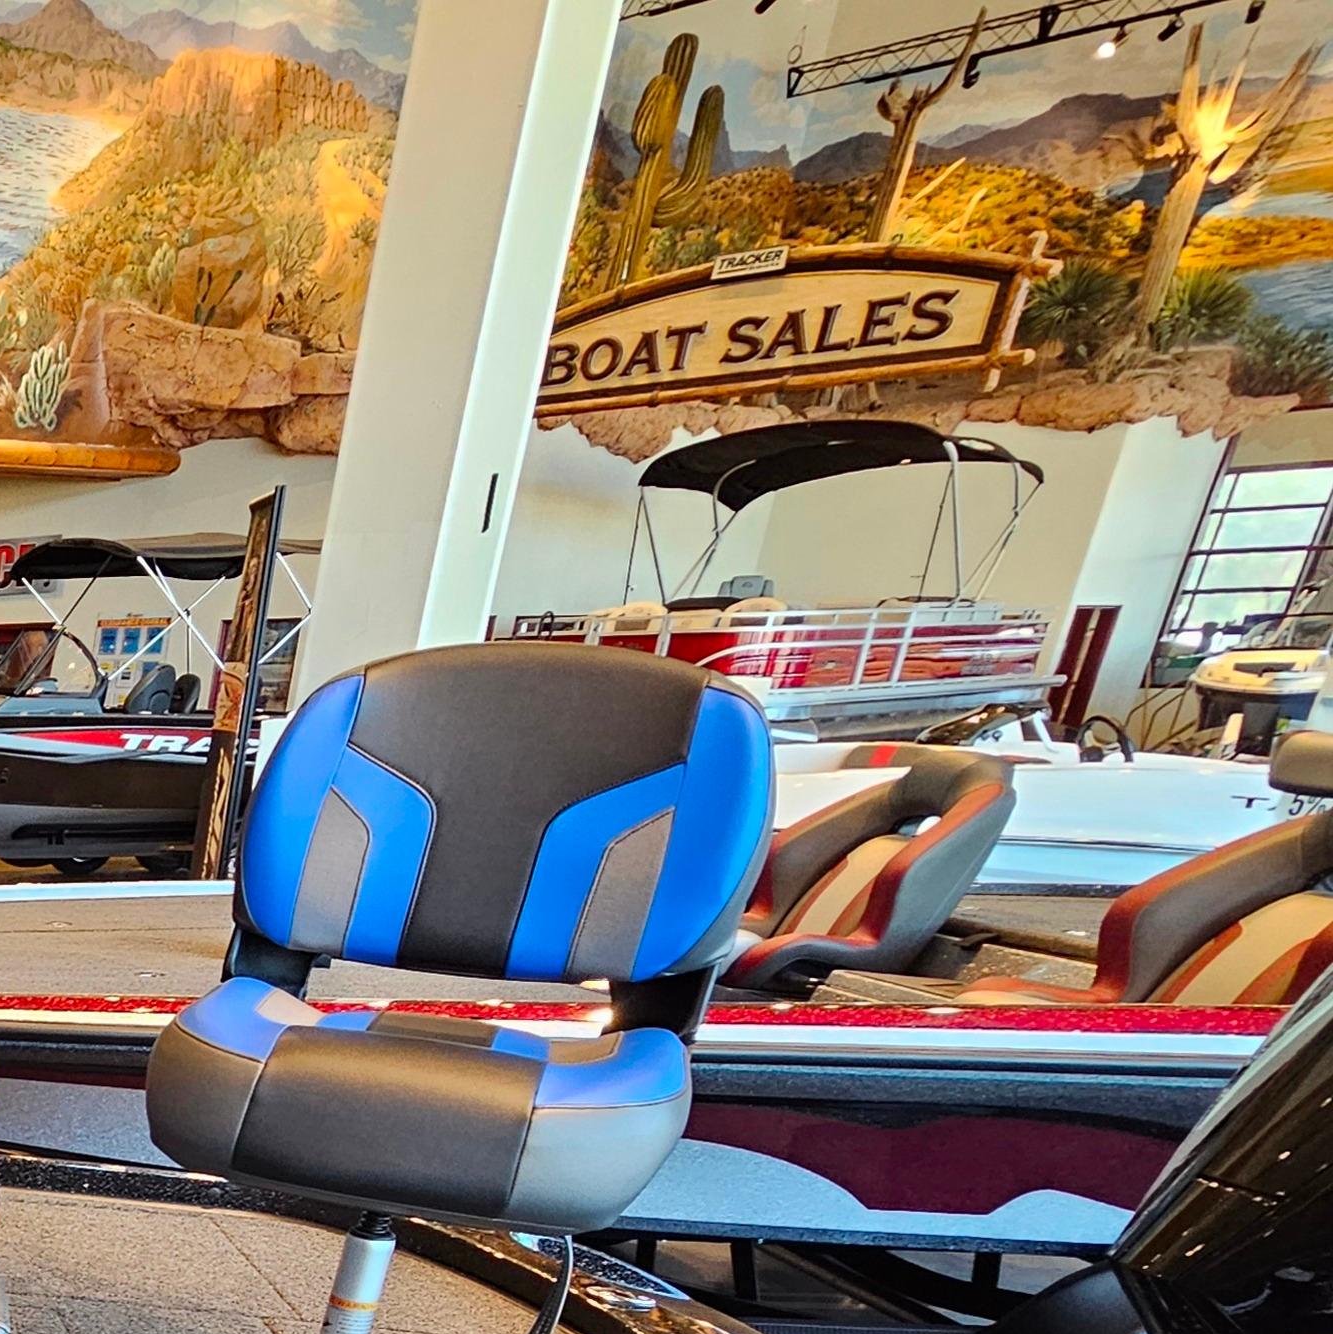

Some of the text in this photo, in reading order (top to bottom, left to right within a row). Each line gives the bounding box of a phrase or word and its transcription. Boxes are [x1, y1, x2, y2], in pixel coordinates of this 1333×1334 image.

[718, 250, 784, 271] TRACKER
[541, 289, 961, 386] BOAT SALES
